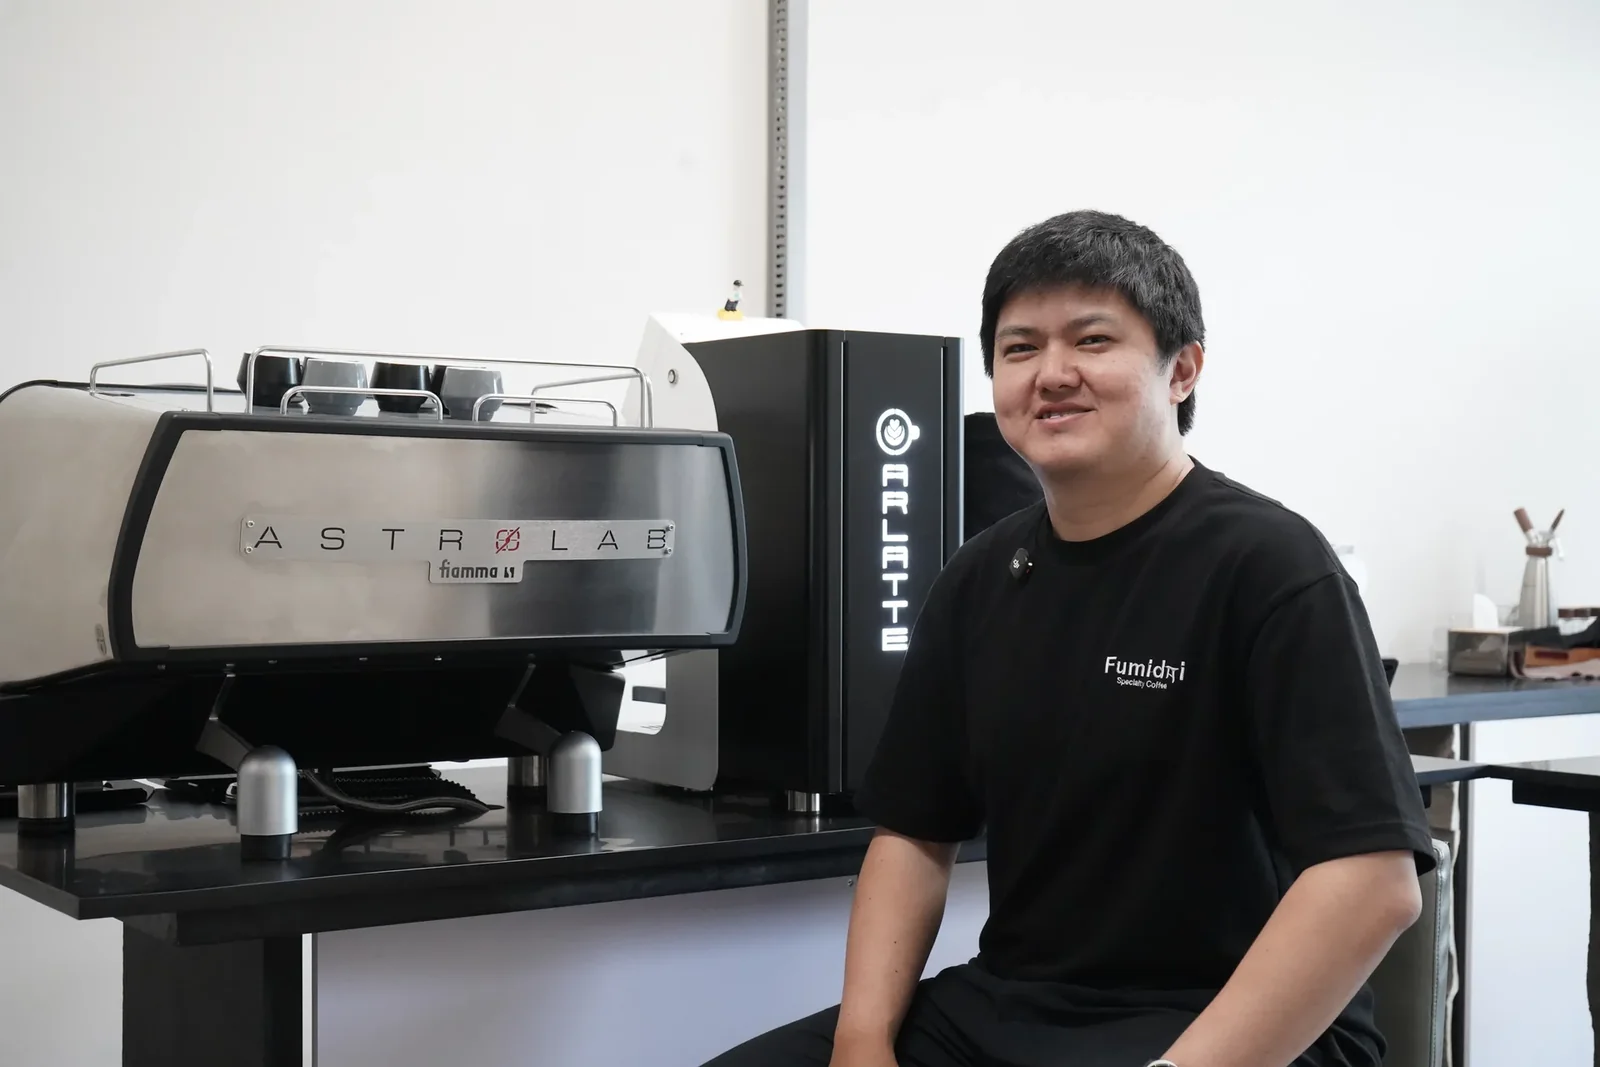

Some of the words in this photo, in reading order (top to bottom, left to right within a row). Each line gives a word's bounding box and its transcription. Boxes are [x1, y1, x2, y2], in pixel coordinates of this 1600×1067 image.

[881, 463, 909, 652] ARLATTE
[439, 559, 498, 579] fiamma
[1116, 676, 1145, 689] Specialty
[1145, 680, 1168, 690] Coffee
